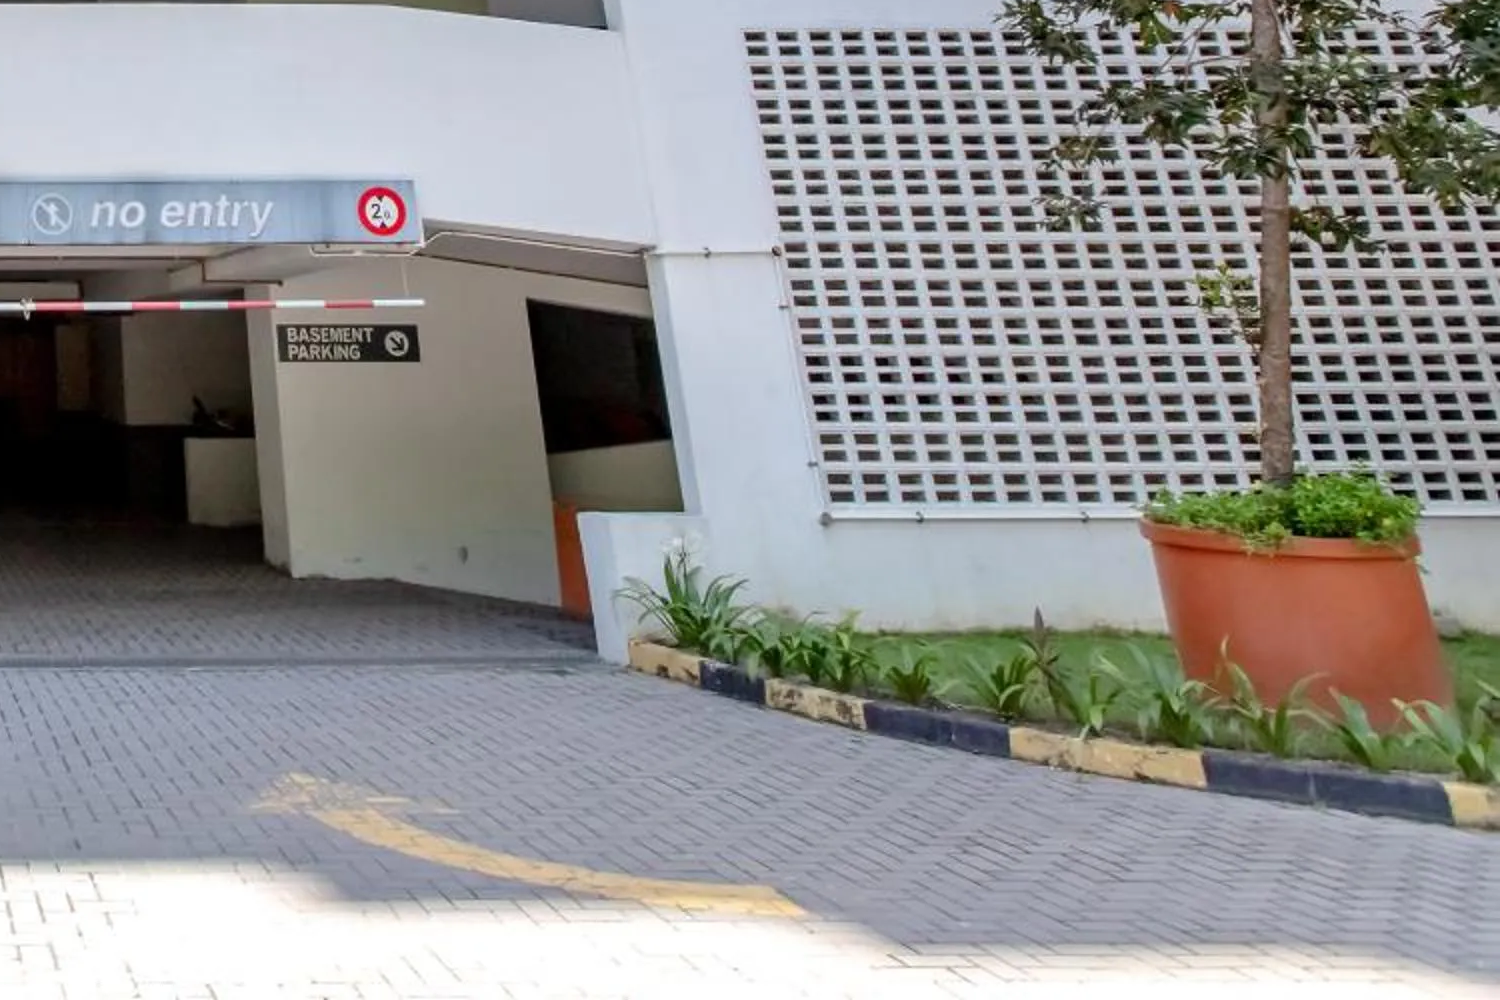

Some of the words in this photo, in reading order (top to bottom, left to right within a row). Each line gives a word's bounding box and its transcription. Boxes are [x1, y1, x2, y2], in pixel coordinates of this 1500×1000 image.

[90, 201, 146, 227] no
[160, 194, 273, 237] entry
[286, 327, 374, 343] BASEMENT
[288, 344, 361, 360] PARKING
